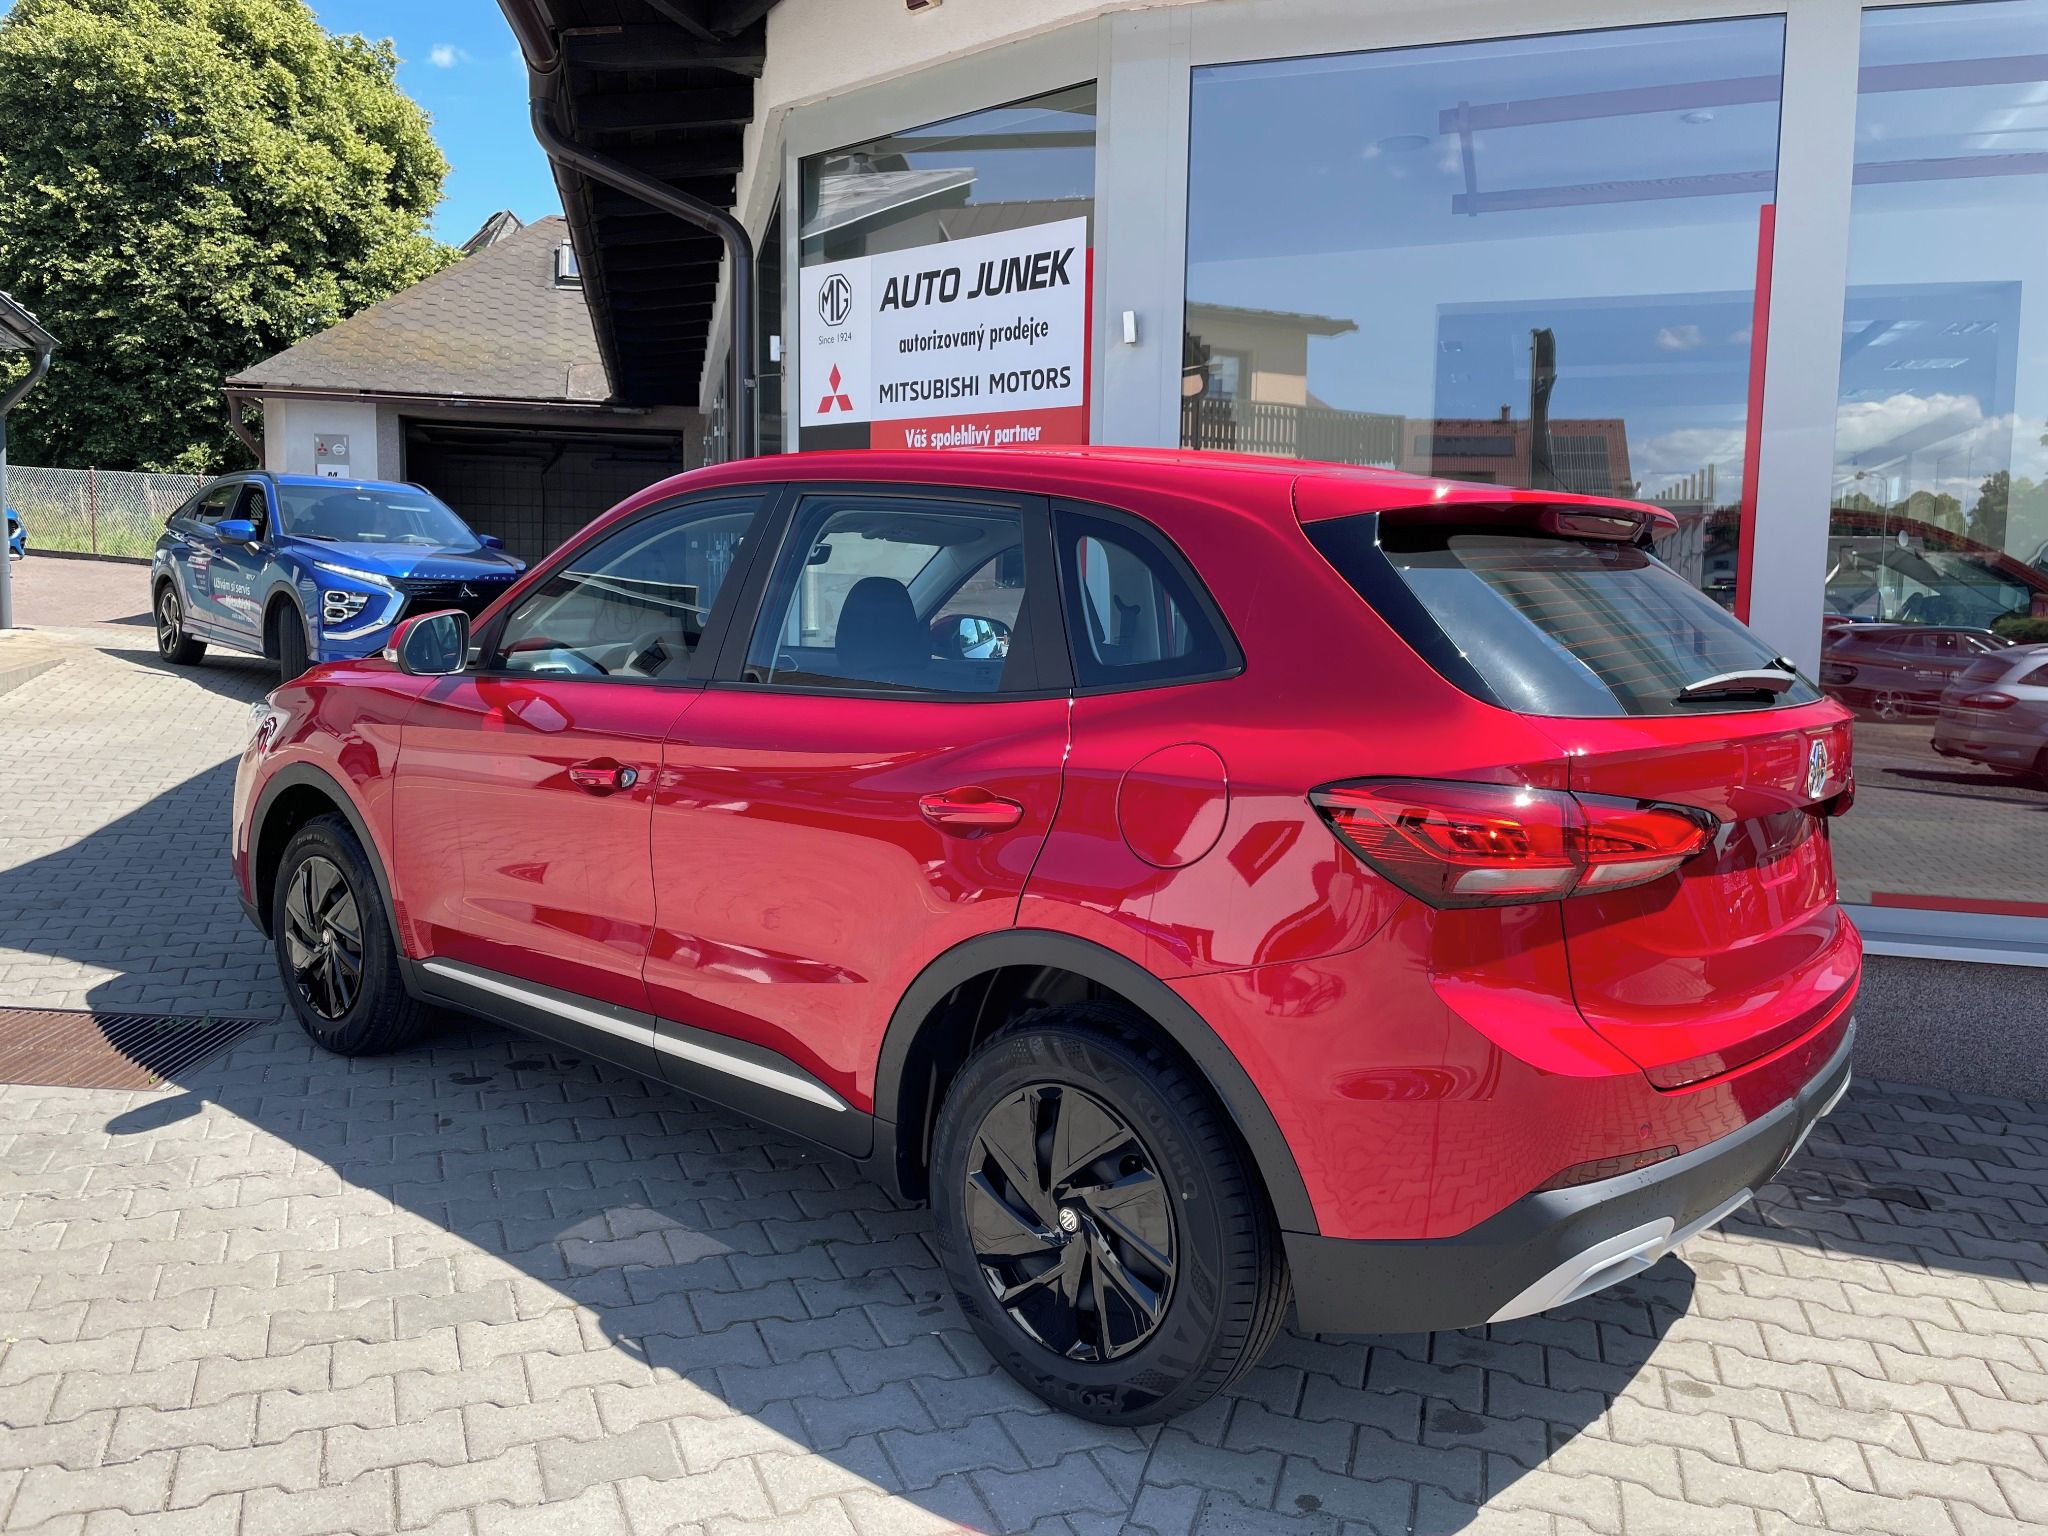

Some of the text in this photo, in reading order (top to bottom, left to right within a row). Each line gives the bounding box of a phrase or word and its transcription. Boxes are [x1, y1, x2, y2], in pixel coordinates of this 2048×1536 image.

[879, 247, 1075, 312] AUTO JUNEK
[820, 275, 850, 325] MG
[818, 332, 852, 345] Since 1924
[899, 316, 1049, 353] autorizovaný prodejce
[879, 366, 1071, 404] MITSUBISHI MOTORS
[905, 424, 1042, 450] Váš spolehlivý partner
[1060, 1209, 1076, 1231] MG
